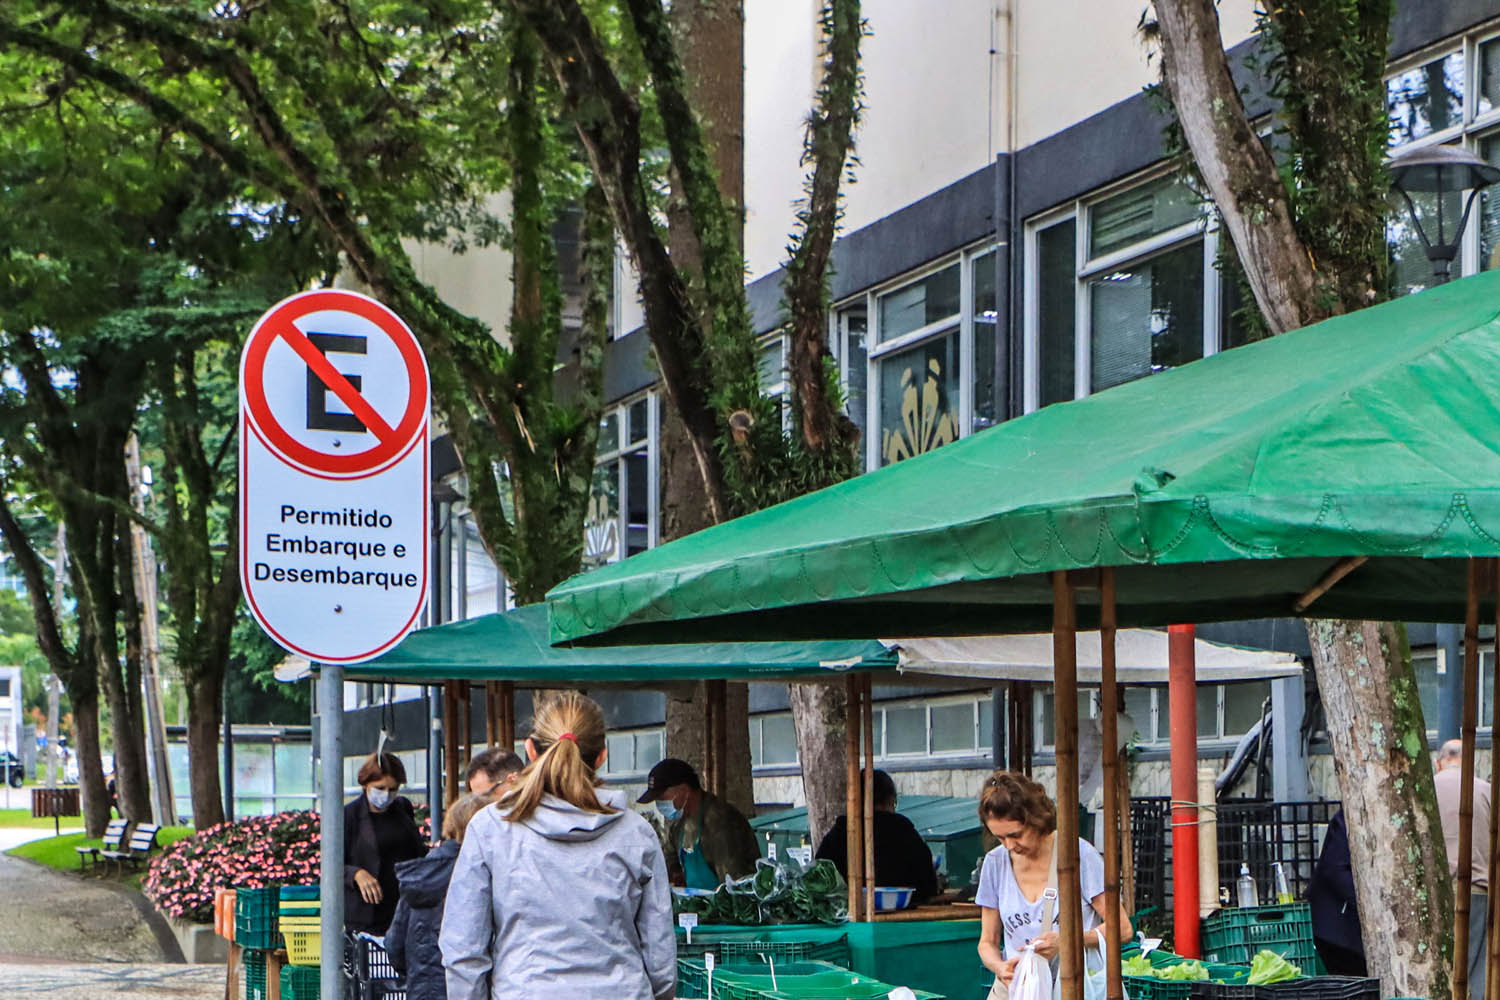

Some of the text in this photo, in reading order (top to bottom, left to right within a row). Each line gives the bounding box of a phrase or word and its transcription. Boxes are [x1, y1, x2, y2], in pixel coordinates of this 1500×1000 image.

[306, 331, 368, 433] E
[280, 504, 393, 528] Permitido
[266, 533, 406, 560] Embarque e
[254, 562, 418, 591] Desembarque
